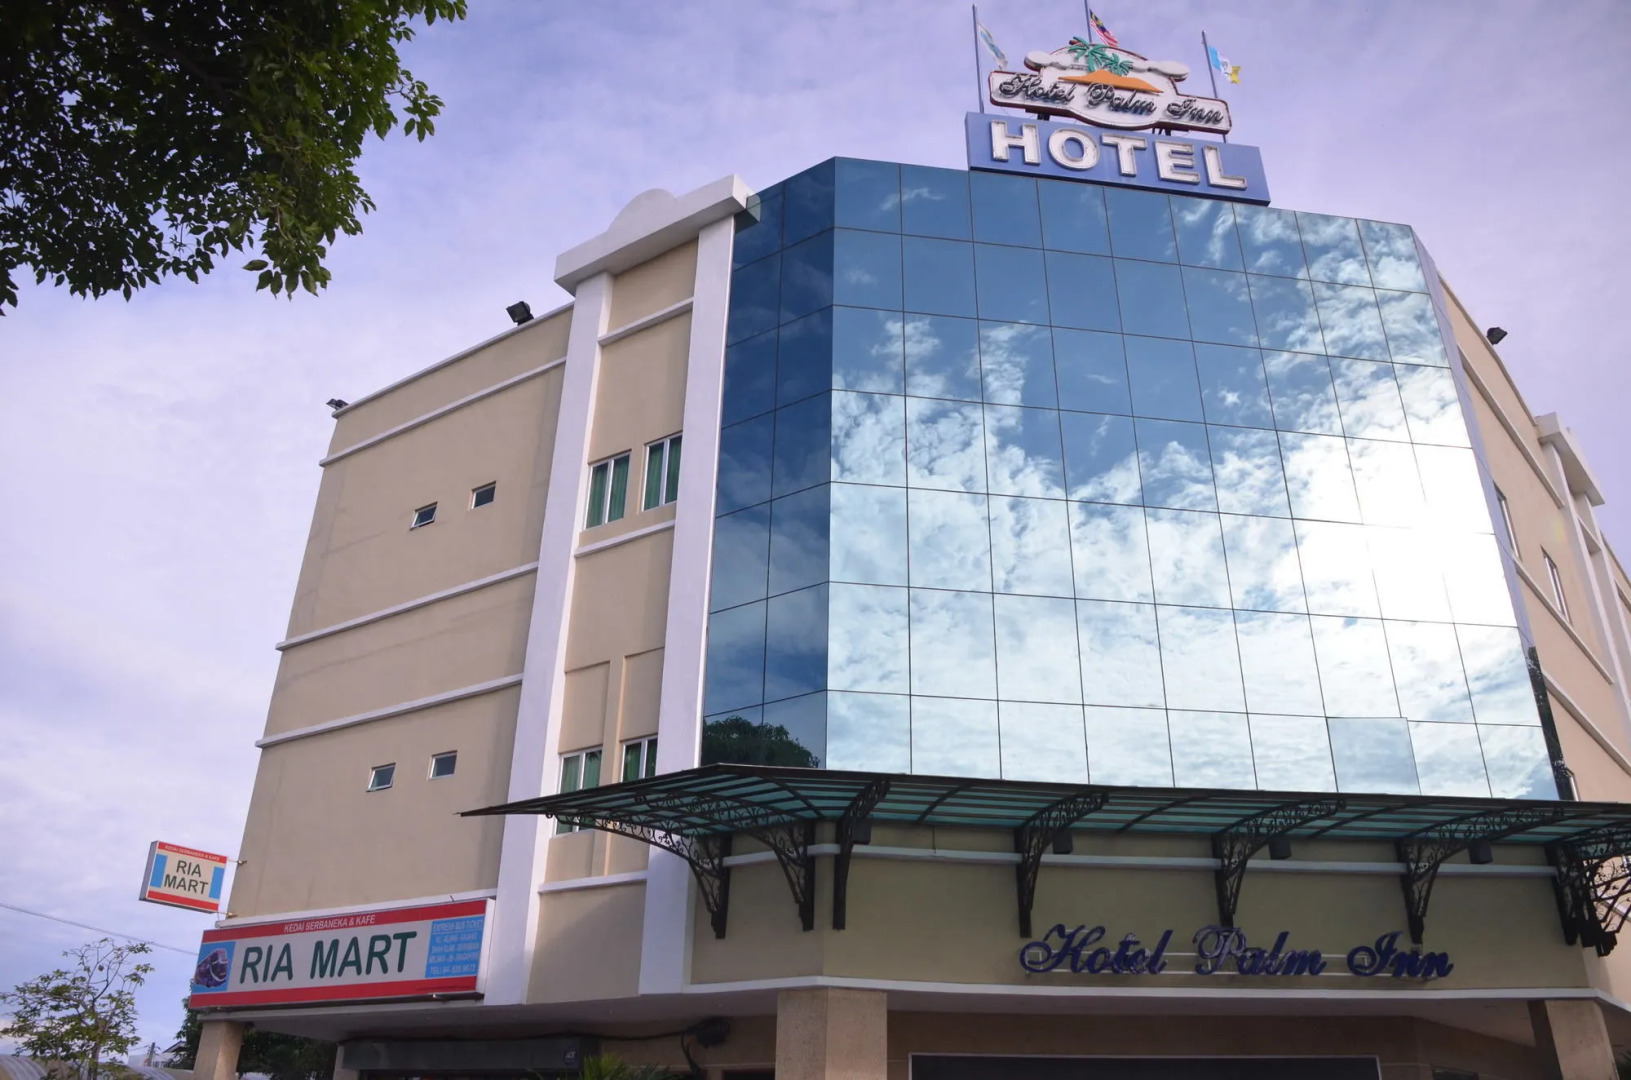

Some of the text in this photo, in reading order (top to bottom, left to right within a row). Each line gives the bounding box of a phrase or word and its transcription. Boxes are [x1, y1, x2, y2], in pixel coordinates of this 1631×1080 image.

[999, 72, 1224, 124] Hotel Palm Inn
[990, 119, 1247, 191] HOTEL
[163, 874, 209, 894] MART
[176, 860, 201, 878] RIA
[283, 914, 376, 933] KEDAI SERBANEKA & KAFE
[239, 931, 417, 984] RIA MART
[1019, 923, 1454, 978] Hotel Palm Inn
